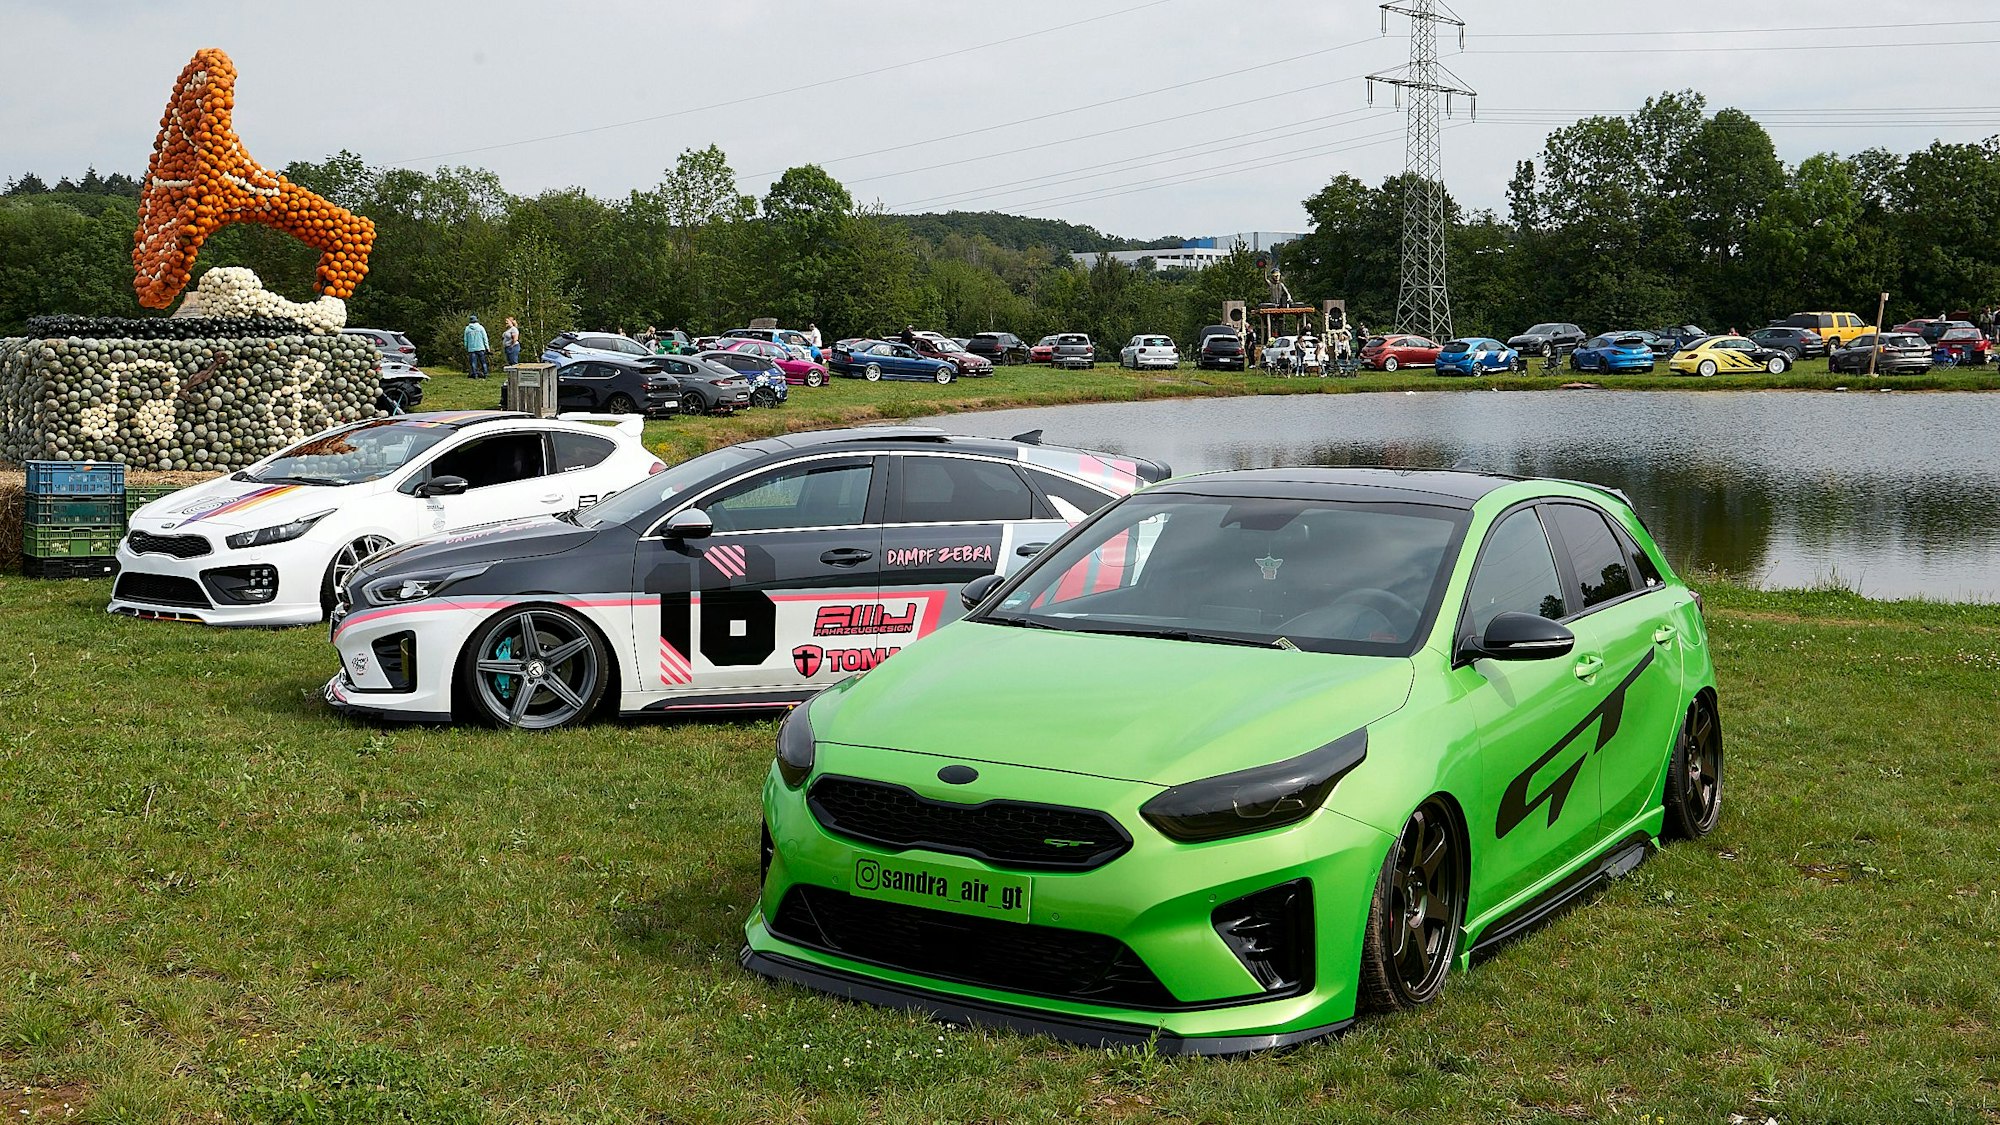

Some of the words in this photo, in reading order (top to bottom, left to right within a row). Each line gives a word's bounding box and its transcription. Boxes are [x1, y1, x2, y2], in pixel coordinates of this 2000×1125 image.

[887, 547, 937, 567] DAMPF
[937, 544, 993, 564] ZEBRA
[644, 544, 777, 684] 16
[814, 624, 913, 637] FAHRZEUGDESIGN
[1496, 646, 1655, 839] GT
[882, 867, 1023, 910] sandra_air_gt
